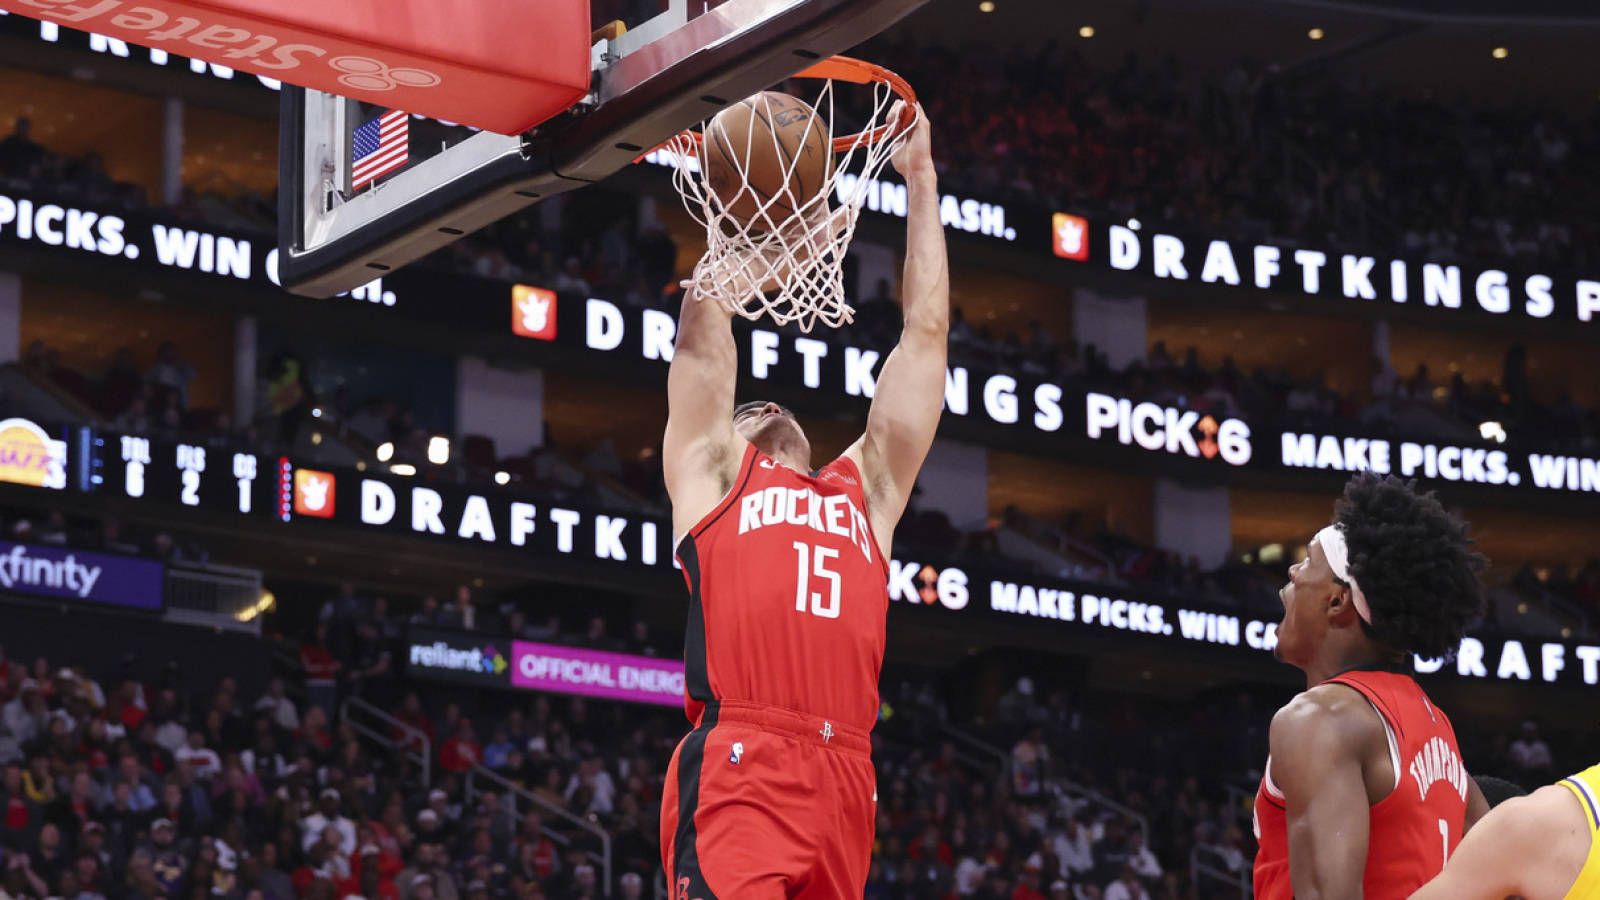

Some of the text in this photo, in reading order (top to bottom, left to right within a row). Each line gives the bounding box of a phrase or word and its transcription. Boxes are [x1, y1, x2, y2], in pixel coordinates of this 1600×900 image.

[0, 195, 139, 260] PICKS.
[152, 224, 251, 280] WIN
[834, 172, 1016, 241] WIN ASH.
[1108, 224, 1555, 318] DRAFTKINGS
[586, 299, 1064, 432] DRFTKNGS
[1281, 432, 1391, 475] MAKE
[1401, 442, 1521, 486] PICKS.
[1528, 453, 1600, 493] WIN
[181, 469, 201, 506] 2
[237, 477, 252, 513] 1
[738, 486, 872, 564] ROCKETS
[361, 479, 684, 570] DRAFTKI
[990, 581, 1076, 622] MAKE
[1081, 595, 1173, 636] PICKS.
[1178, 609, 1240, 647] WIN
[1245, 620, 1279, 651] CA
[793, 541, 841, 619] 15
[410, 641, 483, 672] reliant
[519, 654, 615, 688] OFFICIAL
[1409, 736, 1468, 802] THOMPSON
